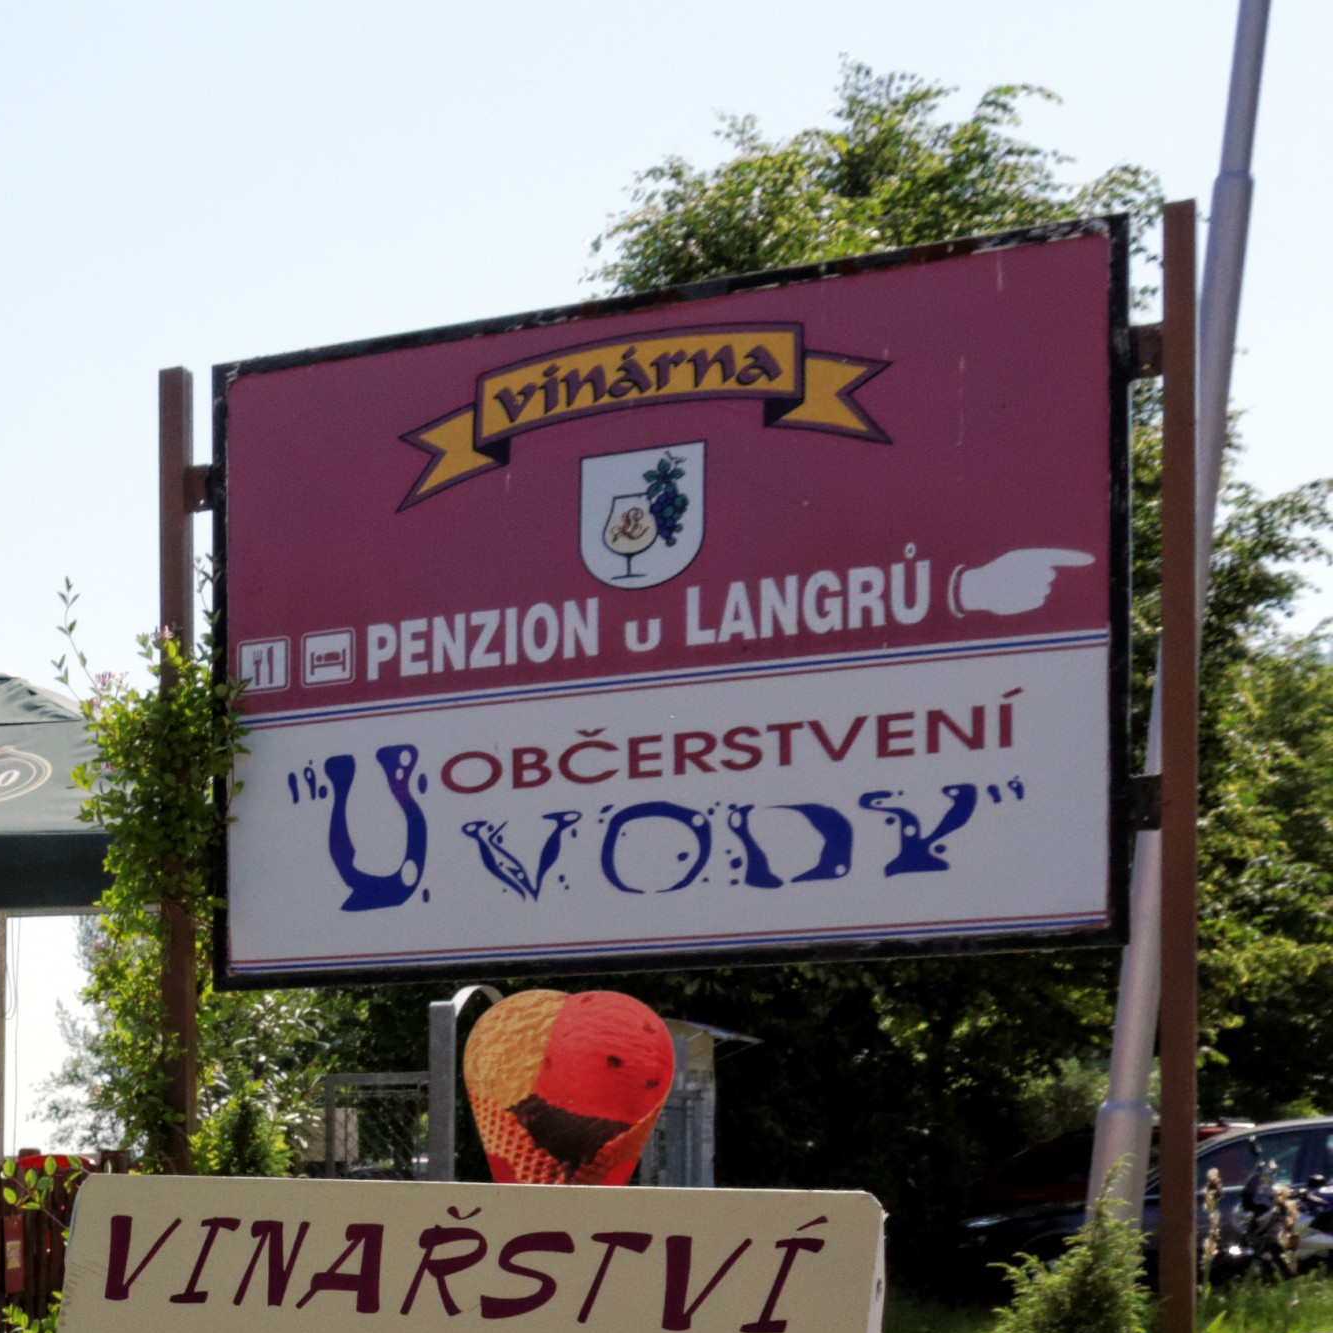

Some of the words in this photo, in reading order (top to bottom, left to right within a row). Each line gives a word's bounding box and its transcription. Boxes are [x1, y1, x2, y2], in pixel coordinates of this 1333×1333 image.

[492, 340, 784, 425] vinárna
[365, 596, 600, 681] PENZION
[685, 540, 932, 648] LANGRŮ
[439, 686, 1024, 794] OBČERSTVENÍ
